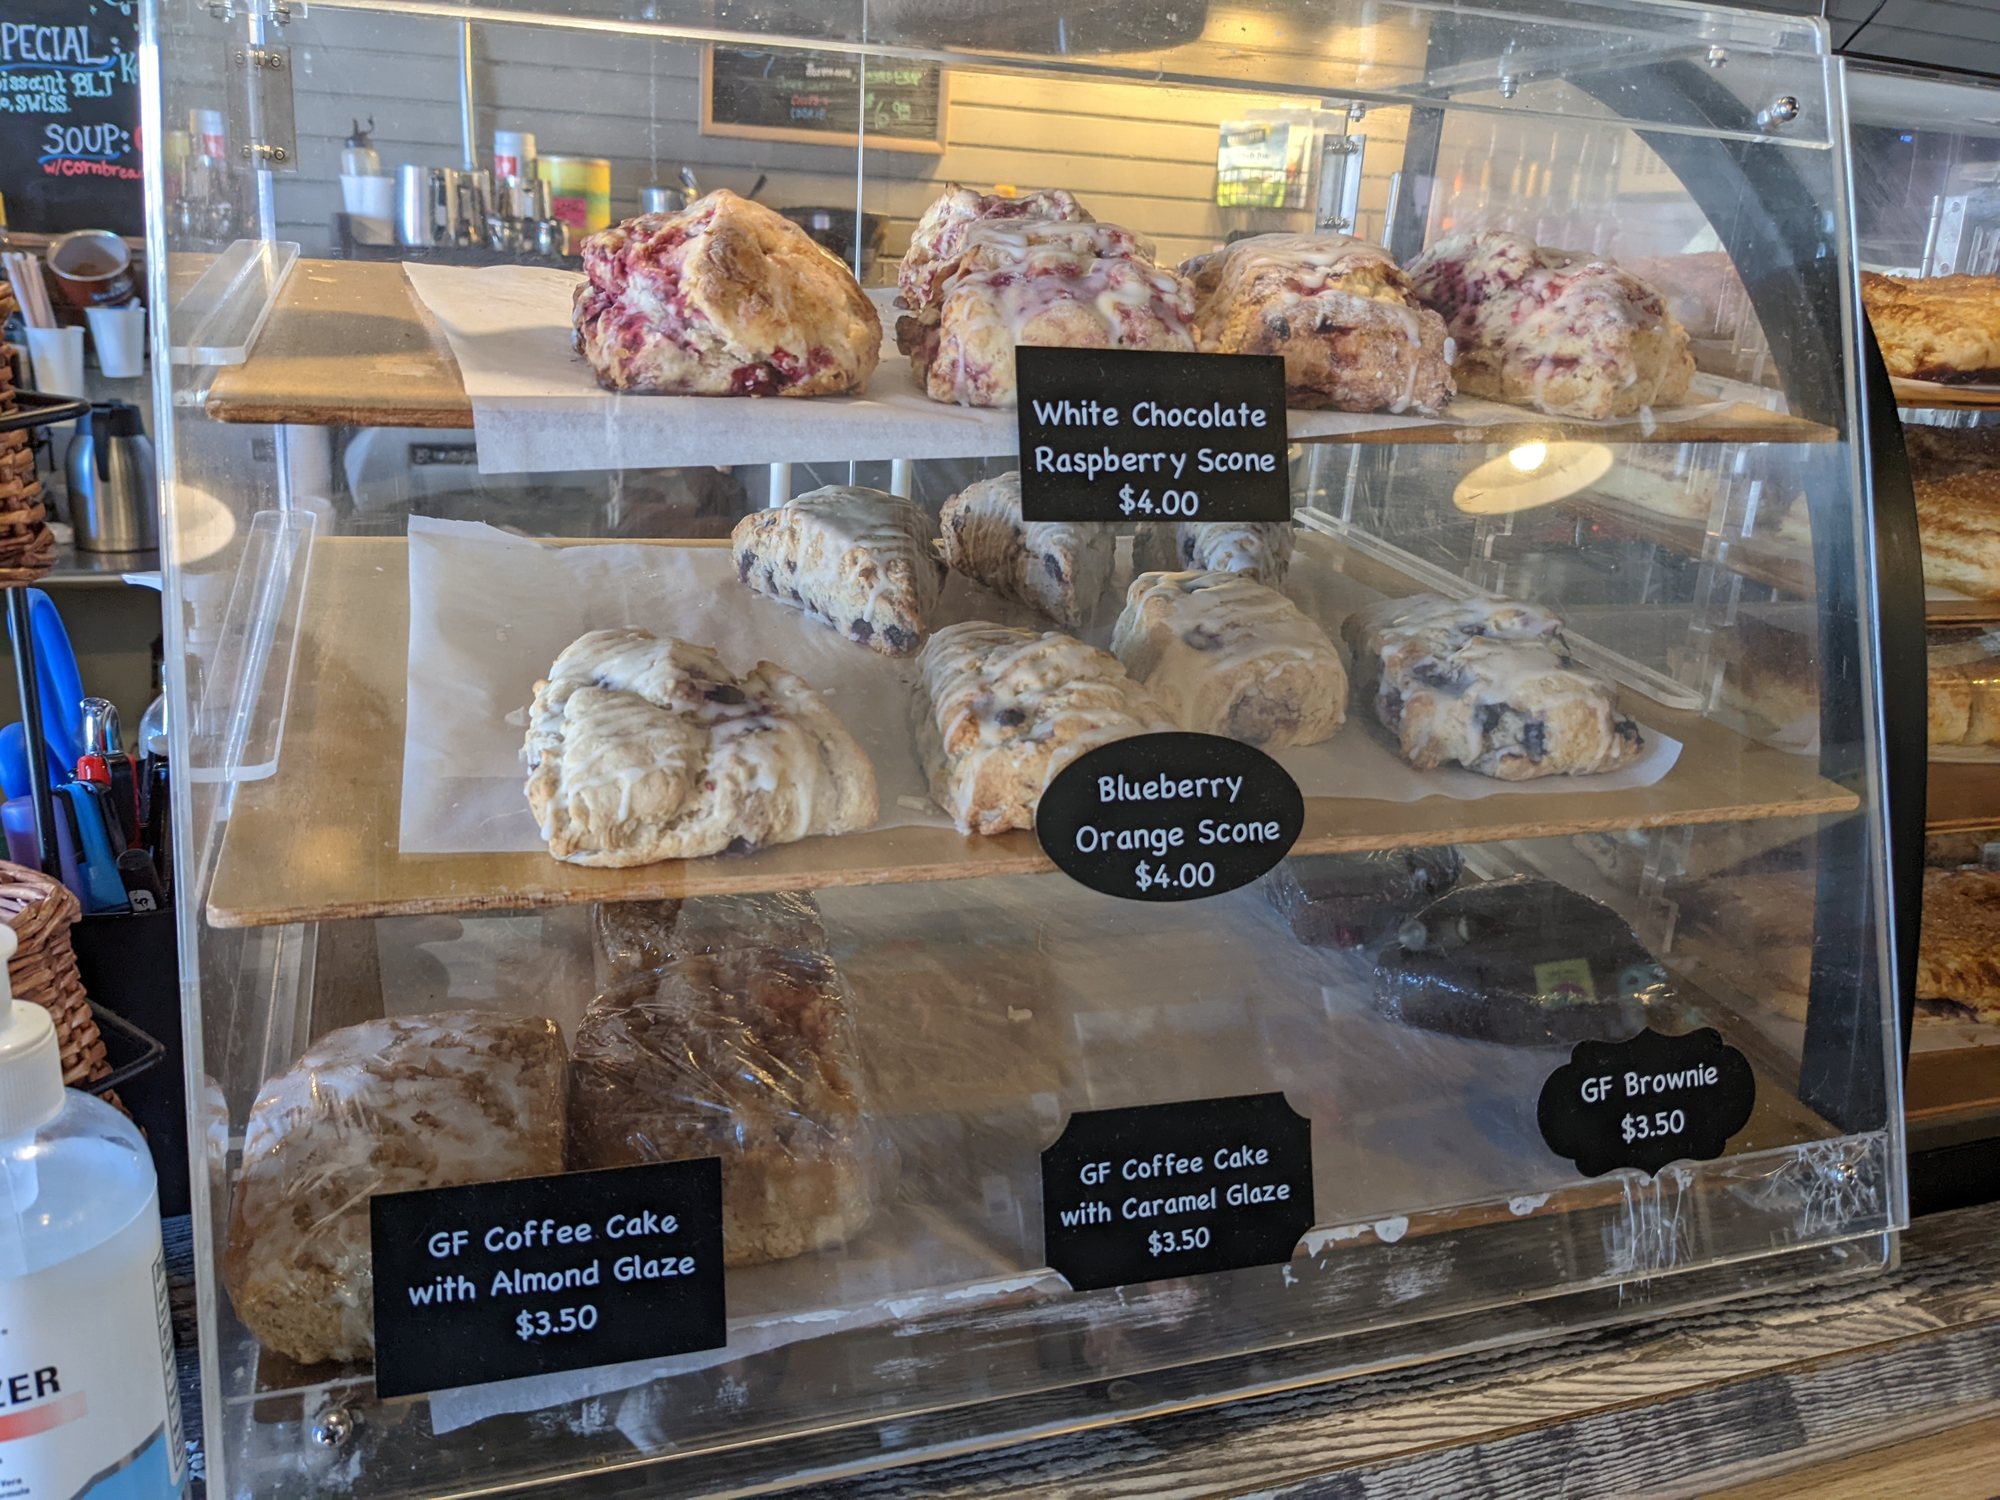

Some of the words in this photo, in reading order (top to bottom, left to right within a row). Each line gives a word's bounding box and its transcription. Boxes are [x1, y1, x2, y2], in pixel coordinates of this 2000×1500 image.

[0, 70, 67, 94] issant
[71, 71, 115, 97] BLT
[42, 123, 131, 155] SOUP:
[1032, 399, 1119, 427] White
[1132, 401, 1267, 428] Chocolate
[1034, 446, 1186, 481] Raspberry
[1197, 448, 1276, 472] Scone
[1118, 483, 1199, 516] $4.00
[1097, 773, 1243, 803] Blueberry
[1075, 825, 1184, 857] Orange
[1198, 819, 1280, 845] Scone
[1134, 860, 1215, 892] $4.00
[1580, 1075, 1613, 1103] GF
[1623, 1063, 1719, 1097] Brownie
[1620, 1108, 1685, 1144] $3.50
[1080, 1161, 1112, 1186] GF
[1121, 1152, 1204, 1181] Coffee
[1213, 1145, 1270, 1170] Cake
[1060, 1201, 1112, 1227] with
[1121, 1187, 1217, 1220] Caramel
[1226, 1182, 1291, 1206] Glaze
[427, 1230, 470, 1258] GF
[483, 1219, 592, 1252] Coffee
[605, 1210, 679, 1239] Cake
[1148, 1226, 1211, 1257] $3.50
[407, 1275, 477, 1306] with
[489, 1260, 600, 1297] Almond
[613, 1254, 697, 1282] Glaze
[514, 1304, 598, 1341] $3.50
